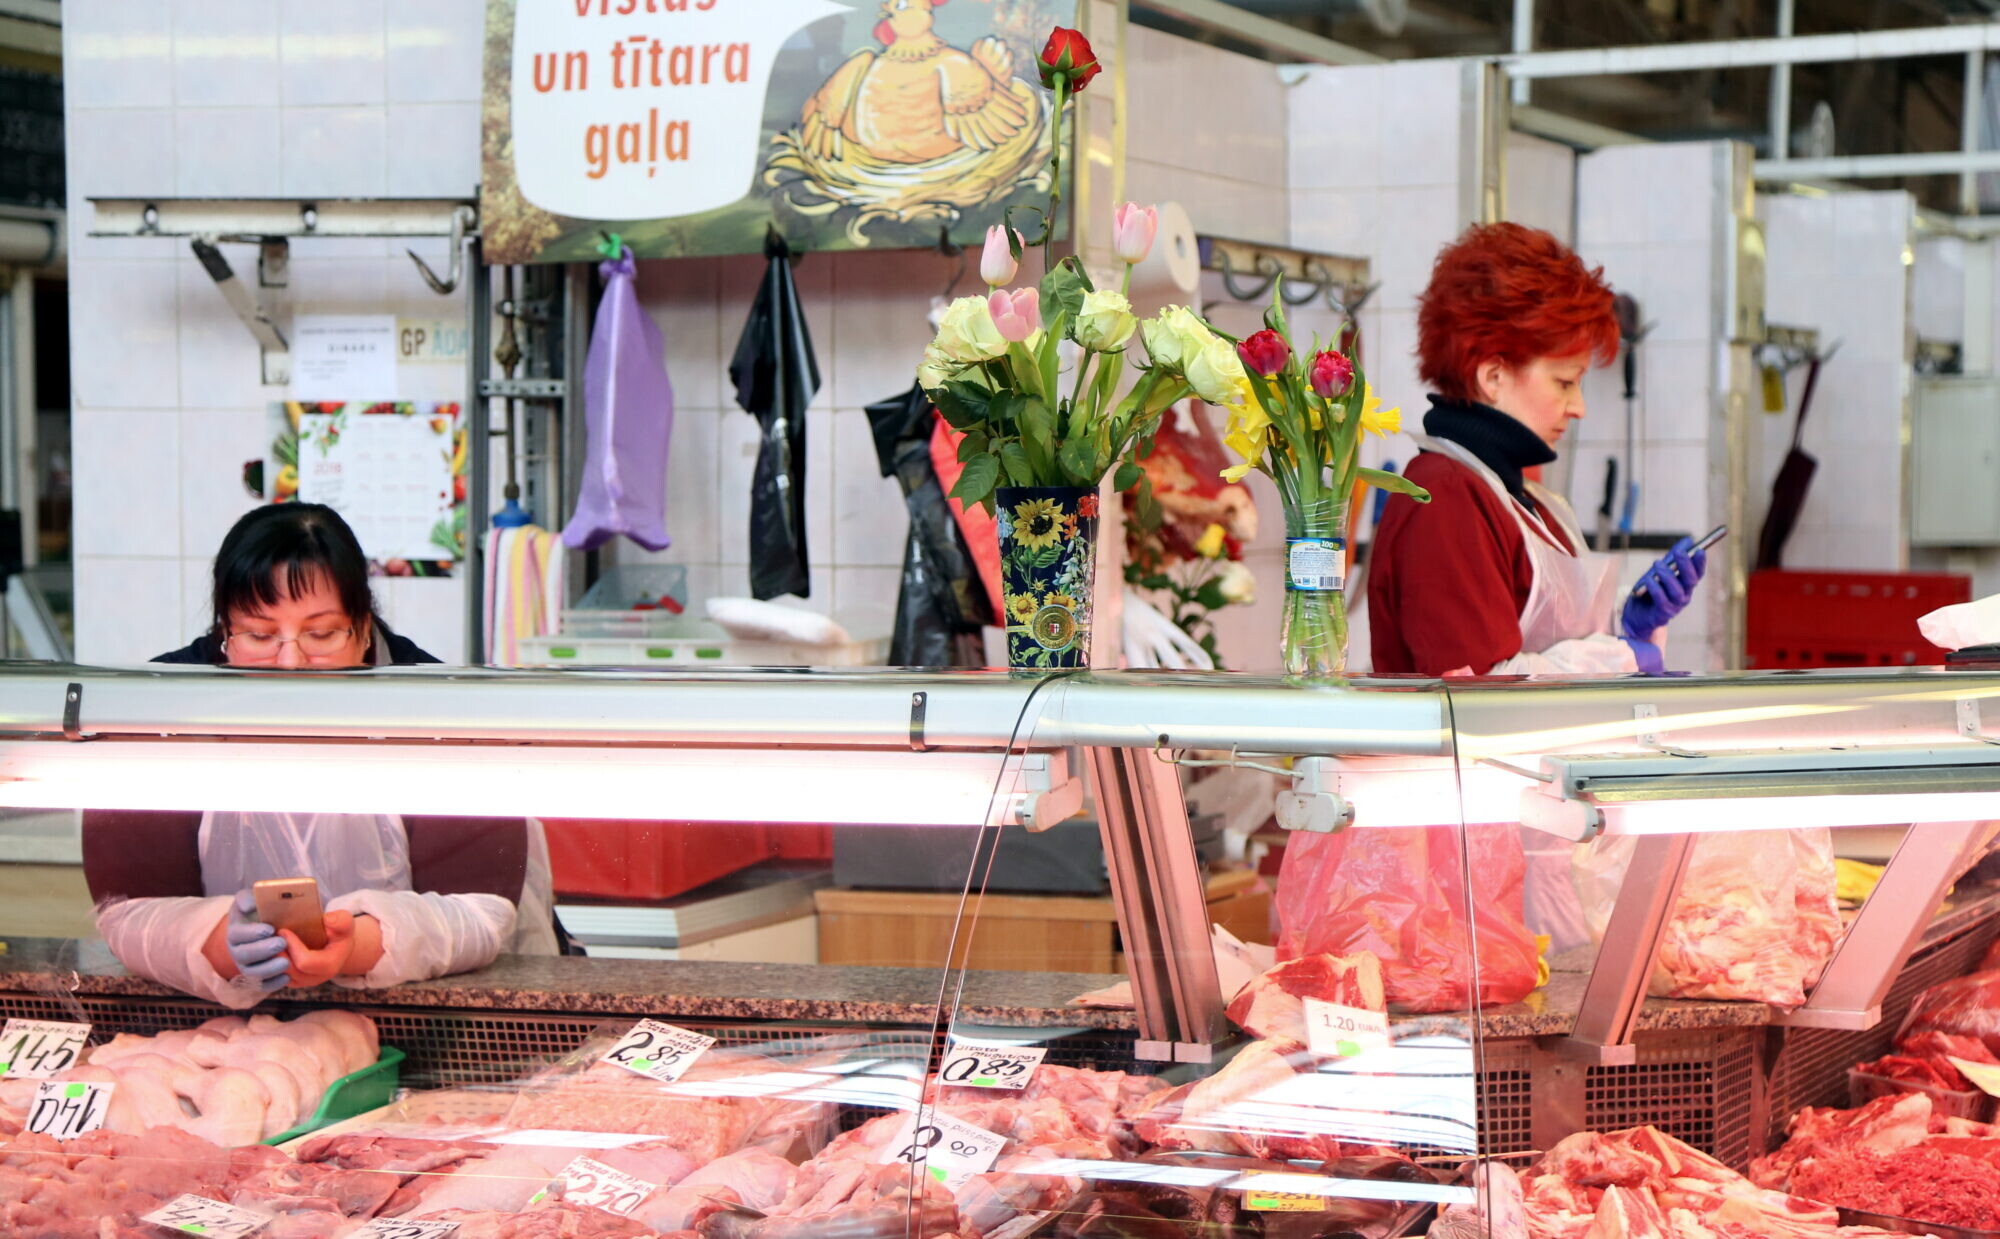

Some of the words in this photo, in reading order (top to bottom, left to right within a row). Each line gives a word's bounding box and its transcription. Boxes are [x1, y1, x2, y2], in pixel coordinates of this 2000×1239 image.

[533, 50, 588, 93] un
[611, 35, 750, 89] tītara
[585, 107, 690, 180] gaļa
[401, 328, 426, 356] GP
[1324, 1014, 1355, 1031] 1.20
